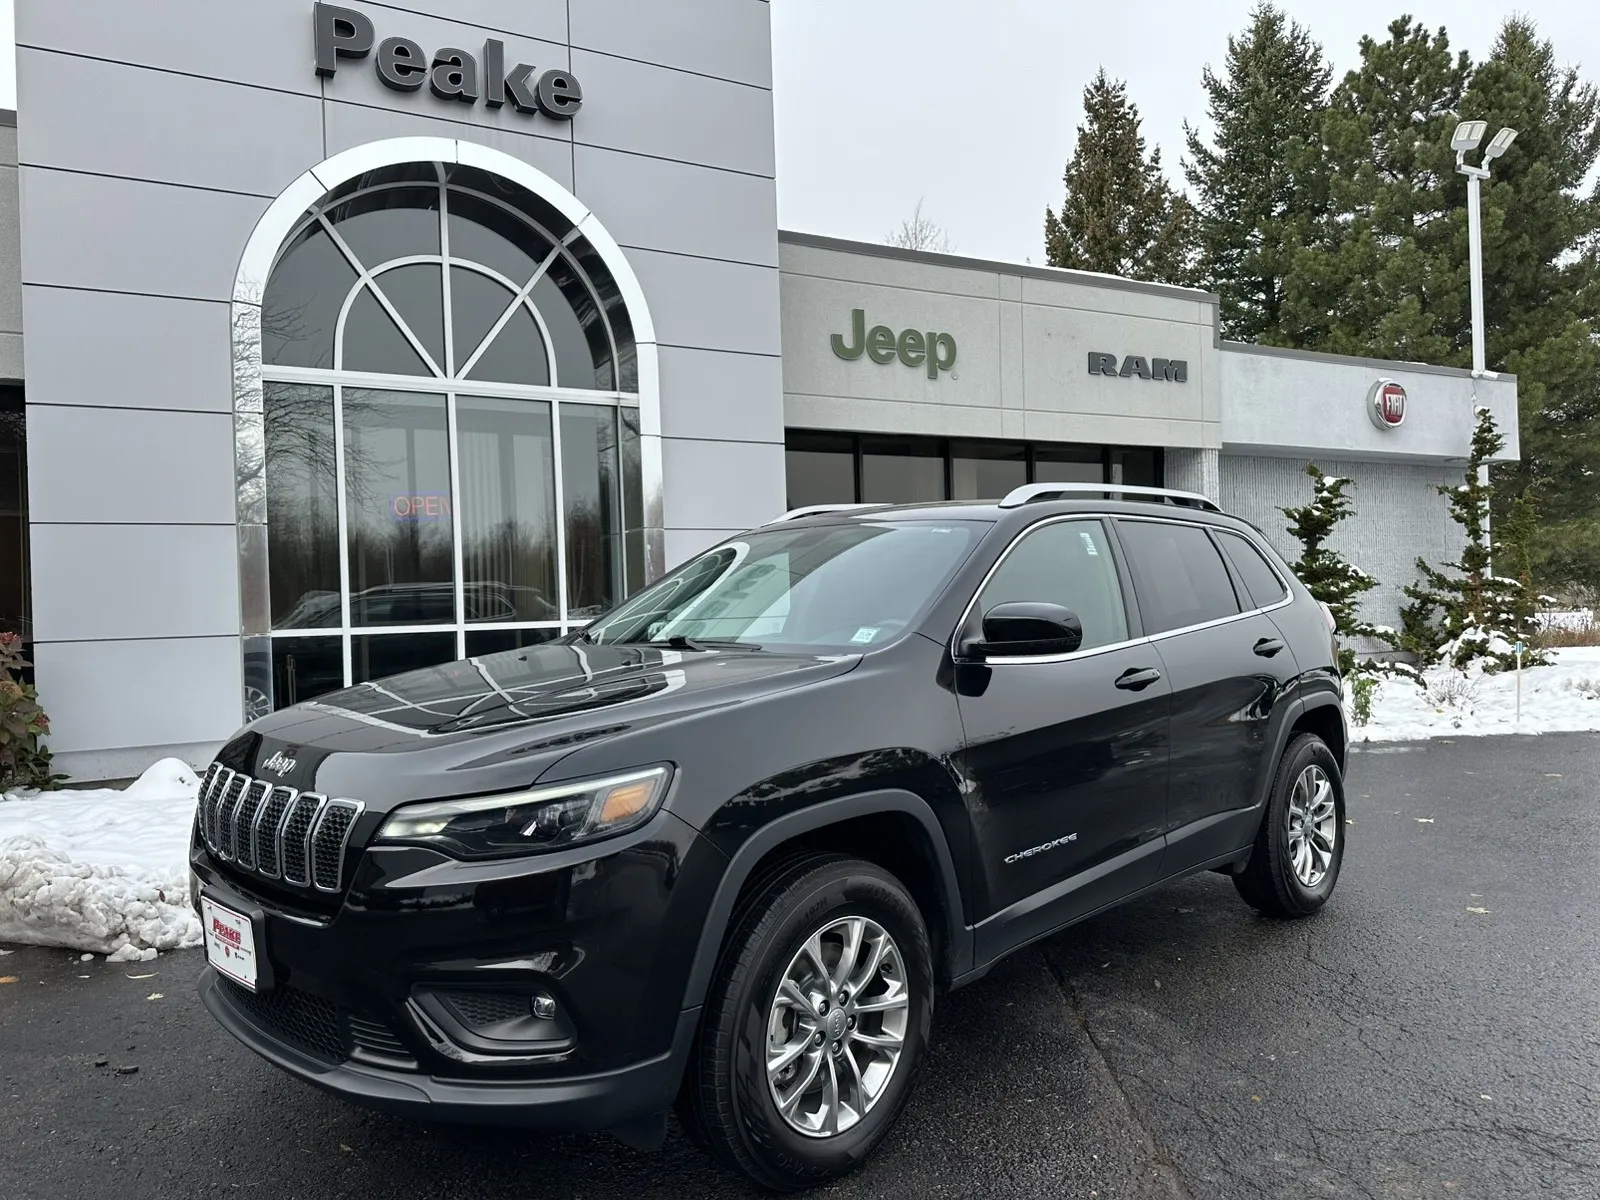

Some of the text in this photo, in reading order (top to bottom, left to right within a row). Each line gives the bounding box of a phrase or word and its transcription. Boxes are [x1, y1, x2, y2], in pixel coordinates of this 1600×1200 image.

[314, 2, 583, 120] Peake
[830, 309, 957, 380] Jeep
[1088, 351, 1188, 382] RAM
[394, 496, 451, 516] OPEN
[262, 751, 297, 777] Jeep
[1004, 832, 1078, 864] CHEROKEE
